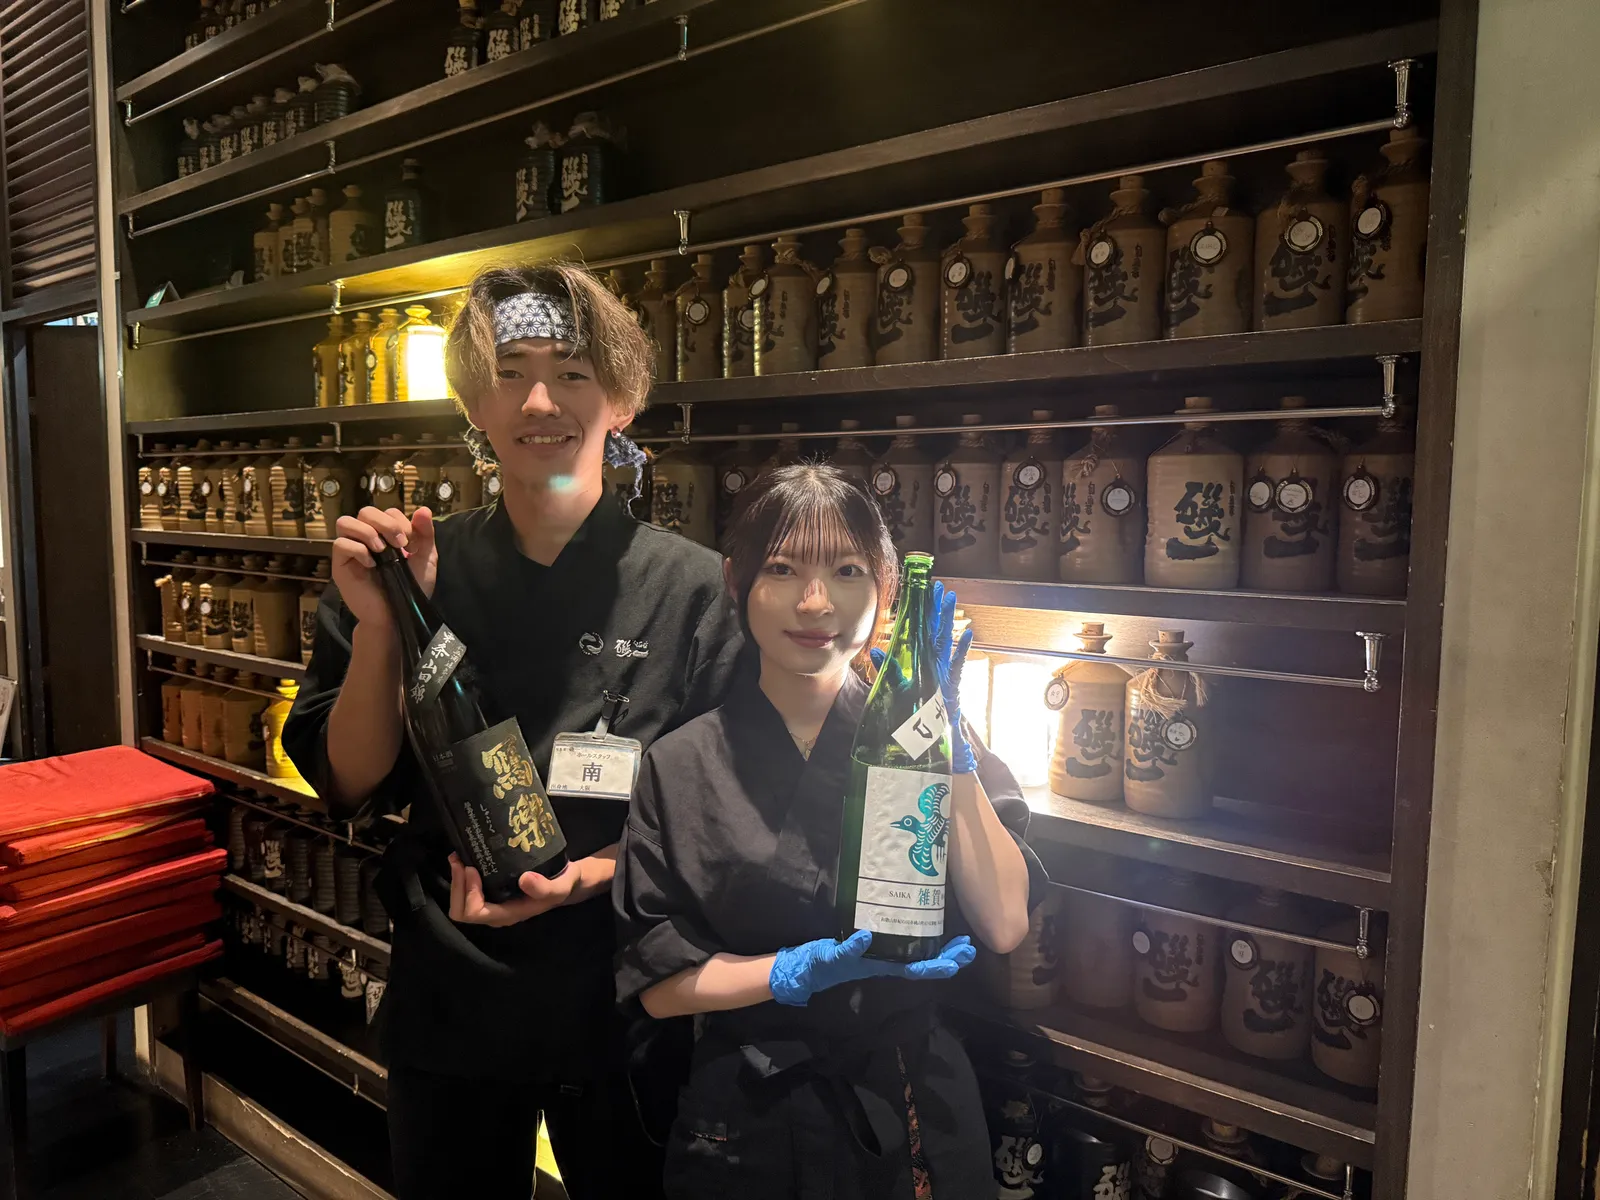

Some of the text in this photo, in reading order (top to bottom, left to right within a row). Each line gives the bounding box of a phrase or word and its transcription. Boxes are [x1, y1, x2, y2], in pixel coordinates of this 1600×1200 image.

[582, 762, 602, 783] 南
[889, 890, 911, 899] SAIKA
[918, 887, 941, 906] 雑賀
